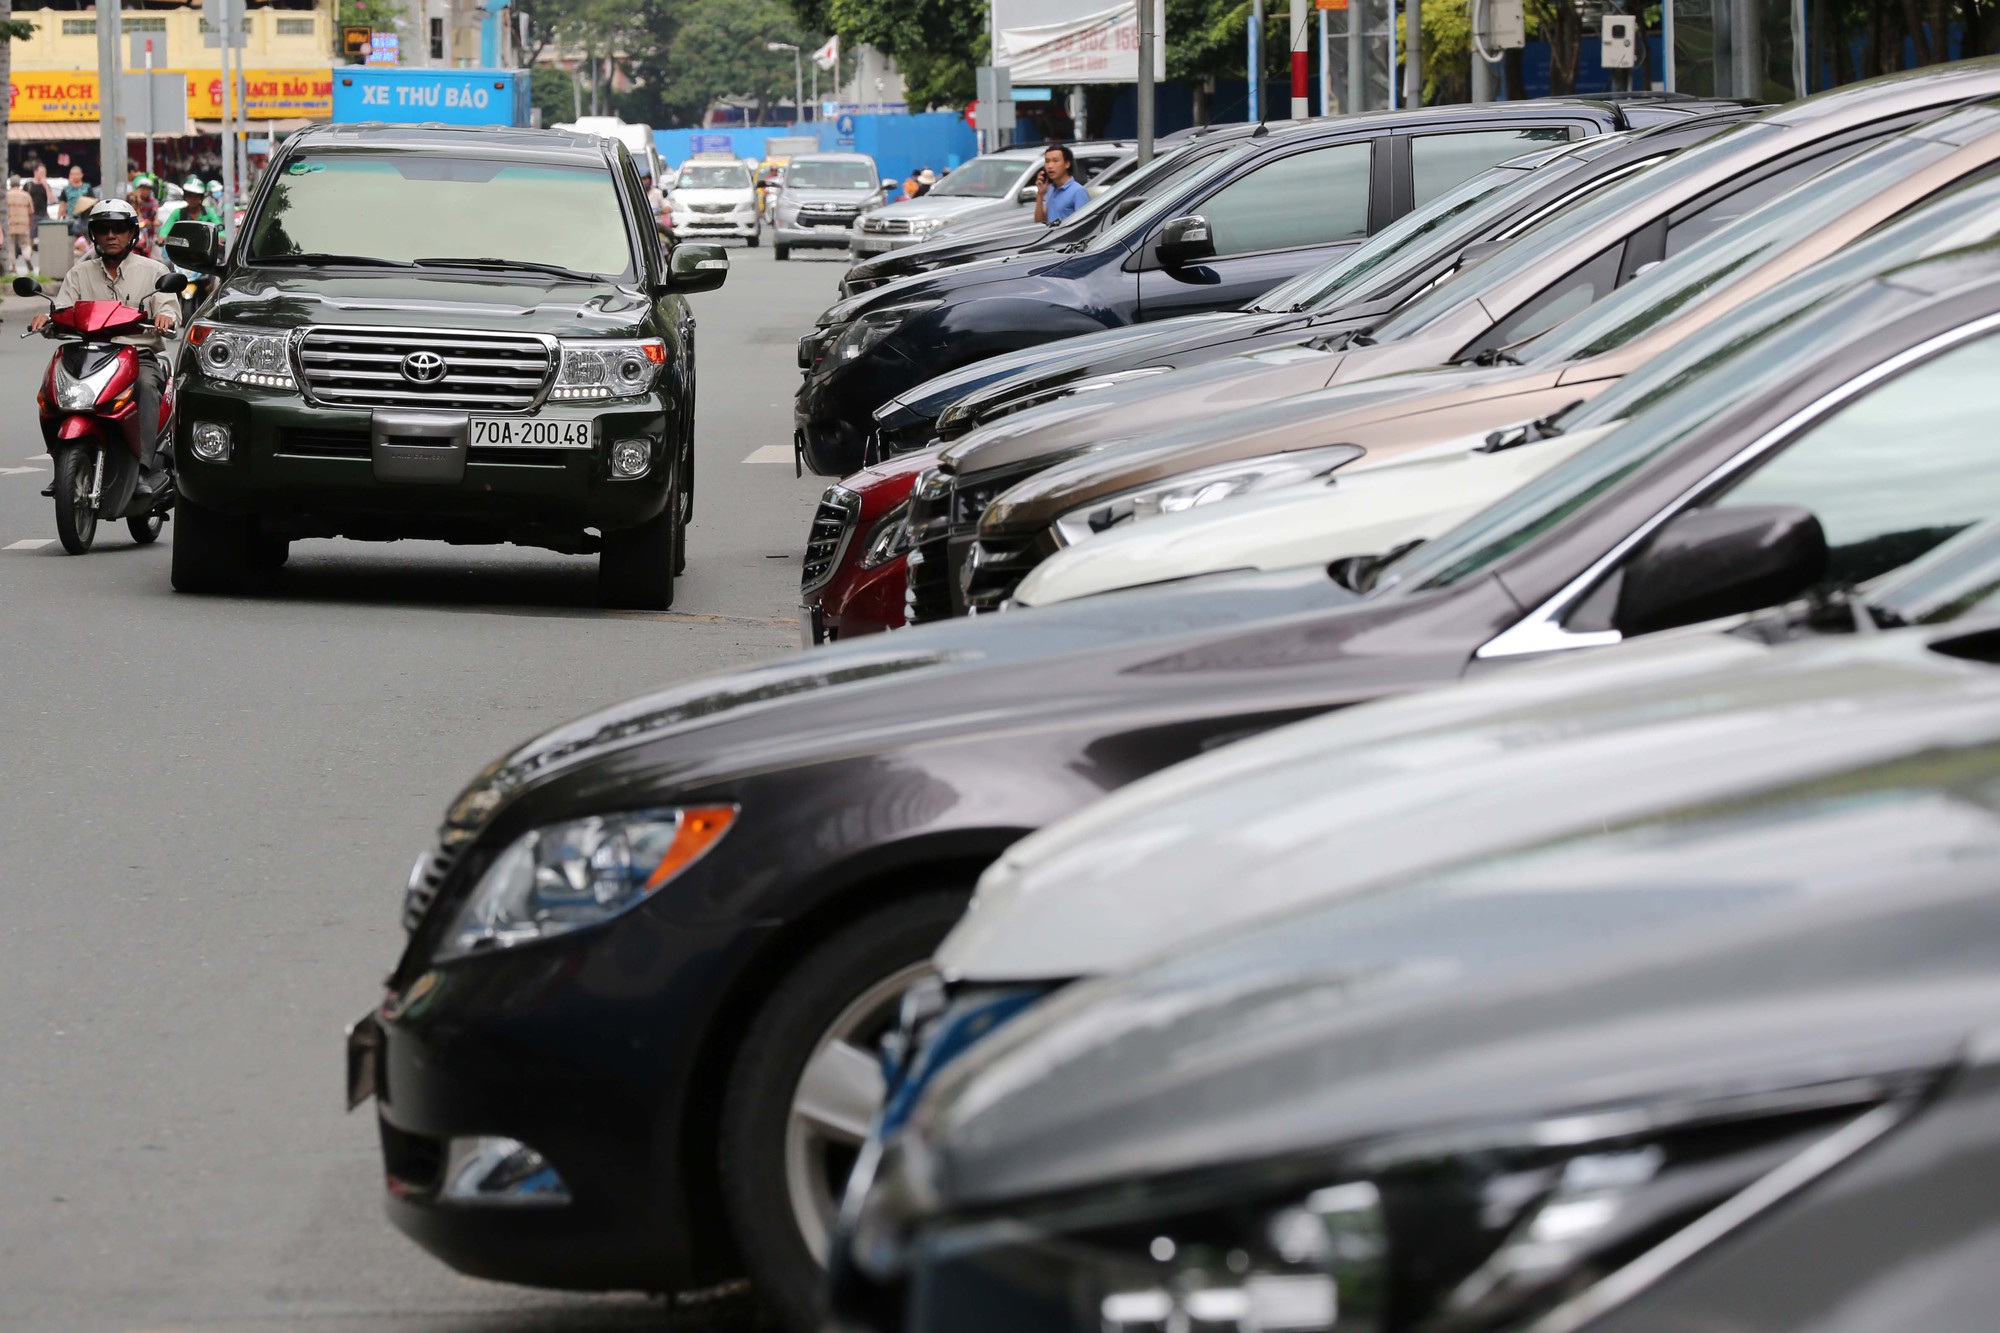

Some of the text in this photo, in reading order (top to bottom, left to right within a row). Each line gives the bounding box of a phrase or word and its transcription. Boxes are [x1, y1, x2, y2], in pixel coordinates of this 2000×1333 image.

[25, 84, 93, 102] THẠCH
[362, 83, 490, 109] XE THƯ BÁO
[475, 422, 588, 445] 70A-200.48
